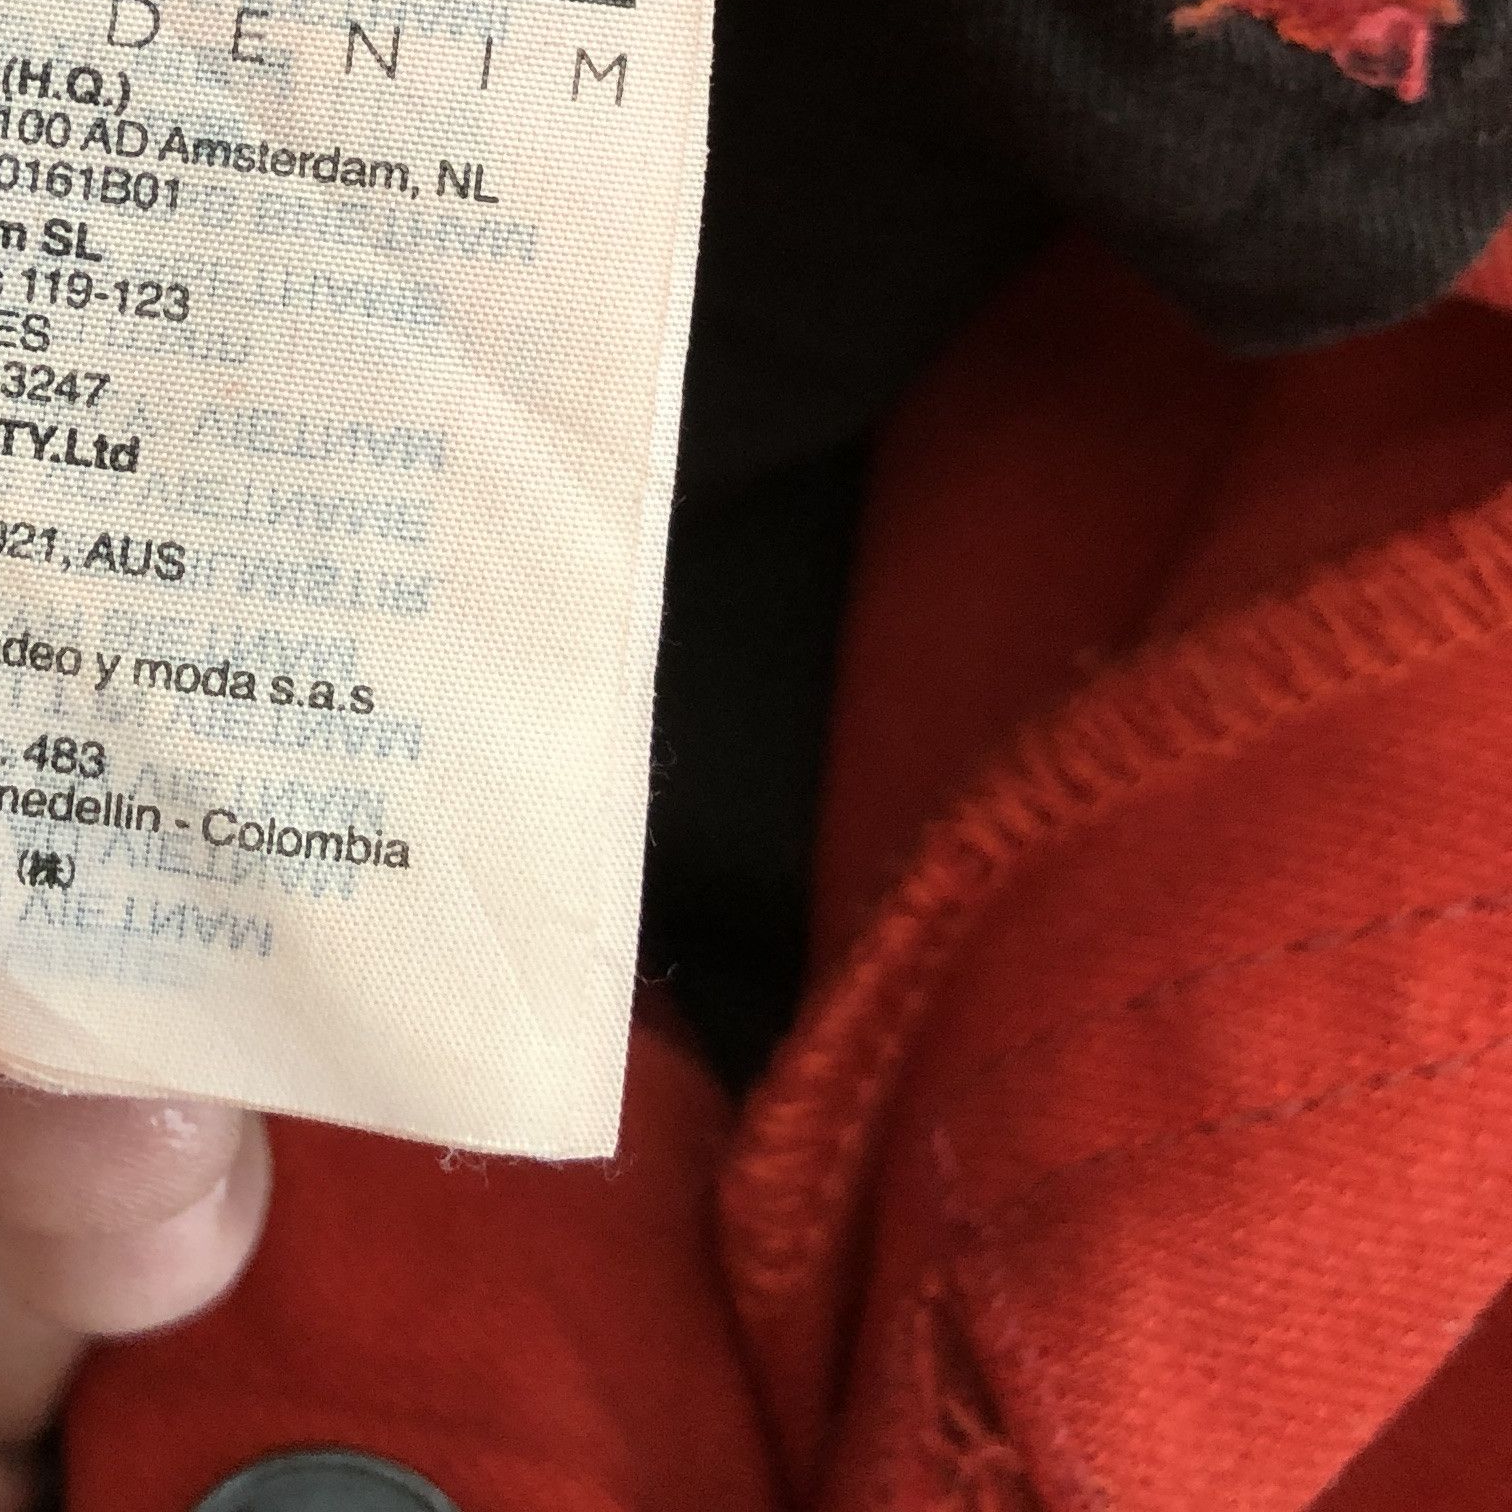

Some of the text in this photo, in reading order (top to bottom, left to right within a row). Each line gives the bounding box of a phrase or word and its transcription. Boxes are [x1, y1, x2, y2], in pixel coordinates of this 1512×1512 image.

[1, 55, 132, 116] (H.Q.)
[80, 117, 149, 159] AD
[159, 127, 419, 200] Amsterdam,
[436, 159, 500, 204] NL
[41, 219, 103, 263] SL
[21, 268, 190, 323] 119-123
[83, 532, 188, 583] AUS
[95, 651, 121, 690] y
[133, 658, 256, 702] moda
[270, 675, 376, 715] s.a.s
[23, 734, 106, 779] 483
[201, 807, 411, 870] Colombia
